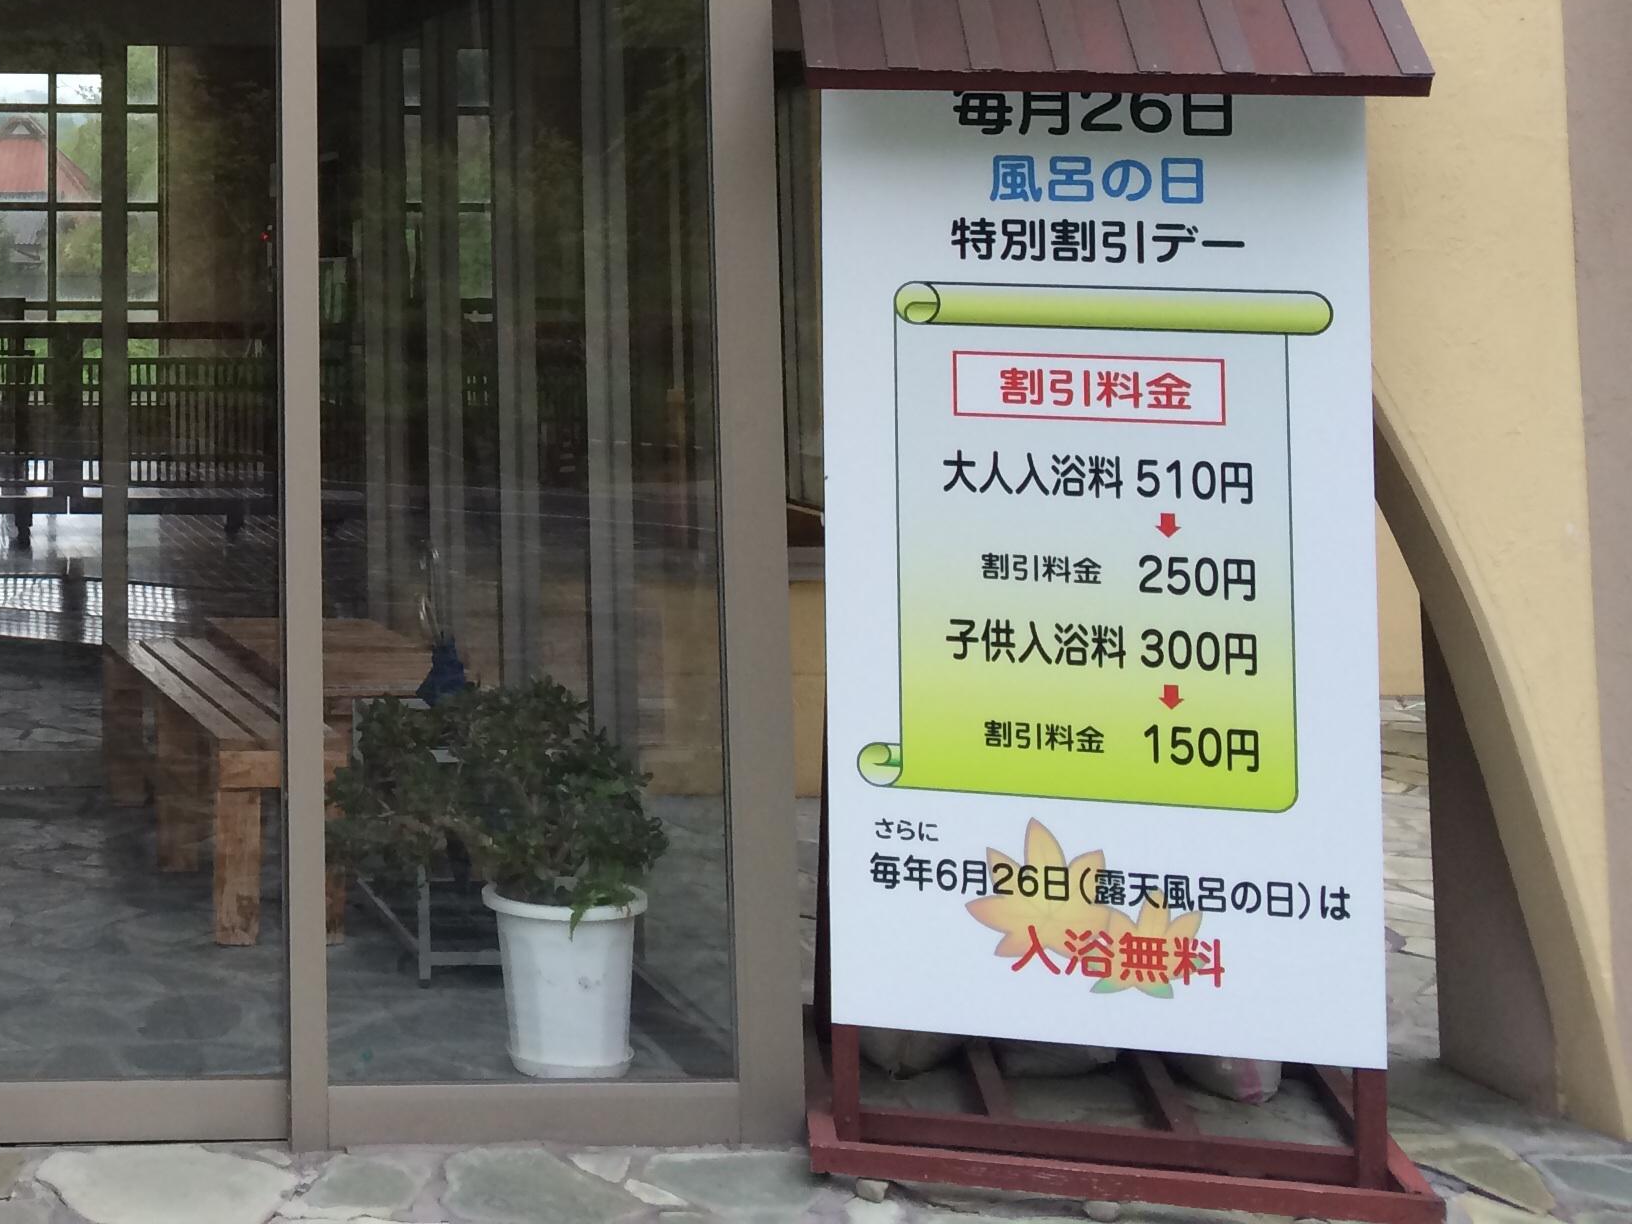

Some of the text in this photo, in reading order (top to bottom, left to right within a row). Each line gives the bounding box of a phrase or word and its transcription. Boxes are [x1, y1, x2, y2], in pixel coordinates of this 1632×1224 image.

[989, 154, 1205, 205] 風呂の日
[951, 217, 1246, 263] 特別割引デー
[999, 368, 1193, 411] 割引料金
[942, 449, 1253, 505] 大人入浴料 510円
[981, 553, 1257, 602] 割引料金 250円
[945, 618, 1258, 676] 子供入浴料 300円
[984, 720, 1260, 773] 割引料金 150円
[873, 817, 940, 843] さらに
[1011, 925, 1225, 988] 入浴無料
